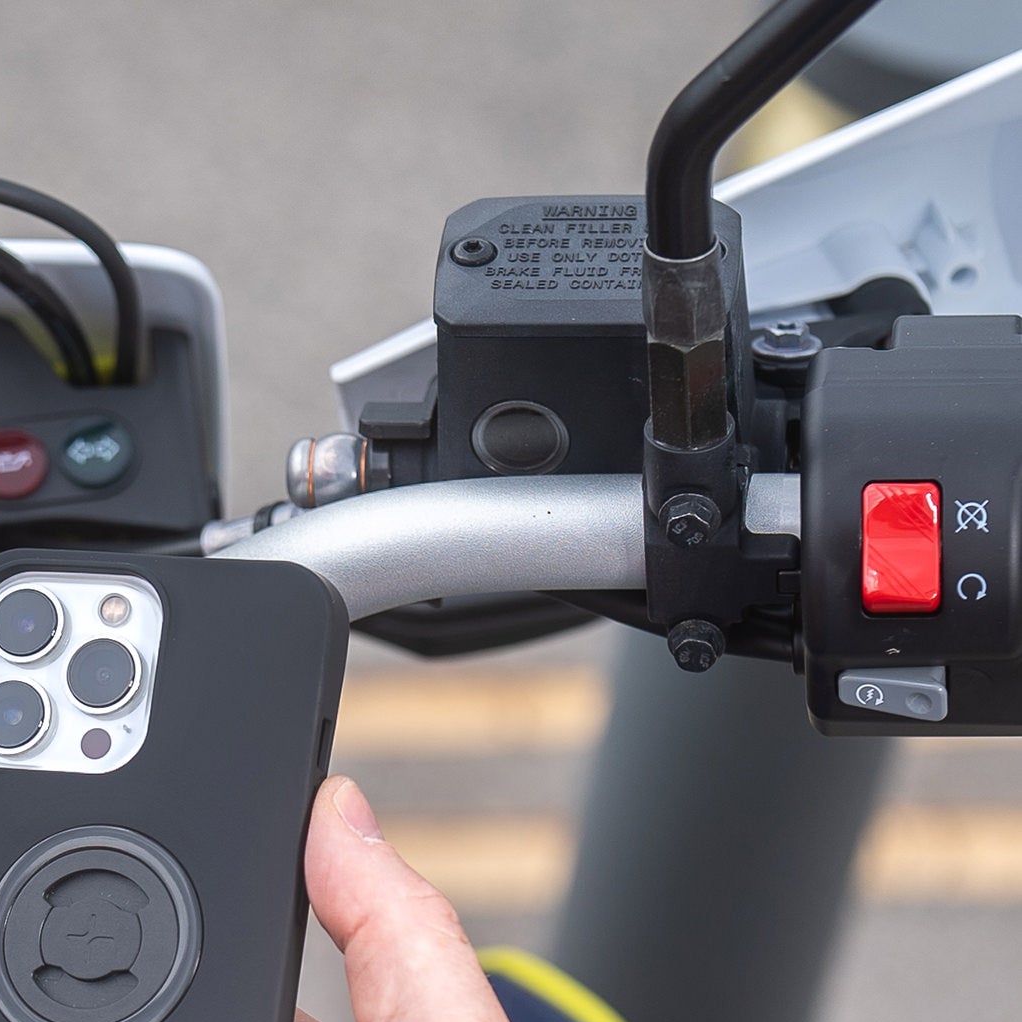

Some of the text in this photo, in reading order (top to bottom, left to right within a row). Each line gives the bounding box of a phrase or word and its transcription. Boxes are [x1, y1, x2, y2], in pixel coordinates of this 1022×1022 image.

[542, 205, 637, 217] WARNING
[498, 223, 555, 235] CLEAN
[566, 223, 632, 235] FILLER
[504, 238, 571, 249] BEFORE
[508, 252, 642, 263] USE ONLY DOT
[485, 266, 541, 277] BRAKE
[552, 266, 609, 277] FLUID
[490, 279, 558, 290] SEALED
